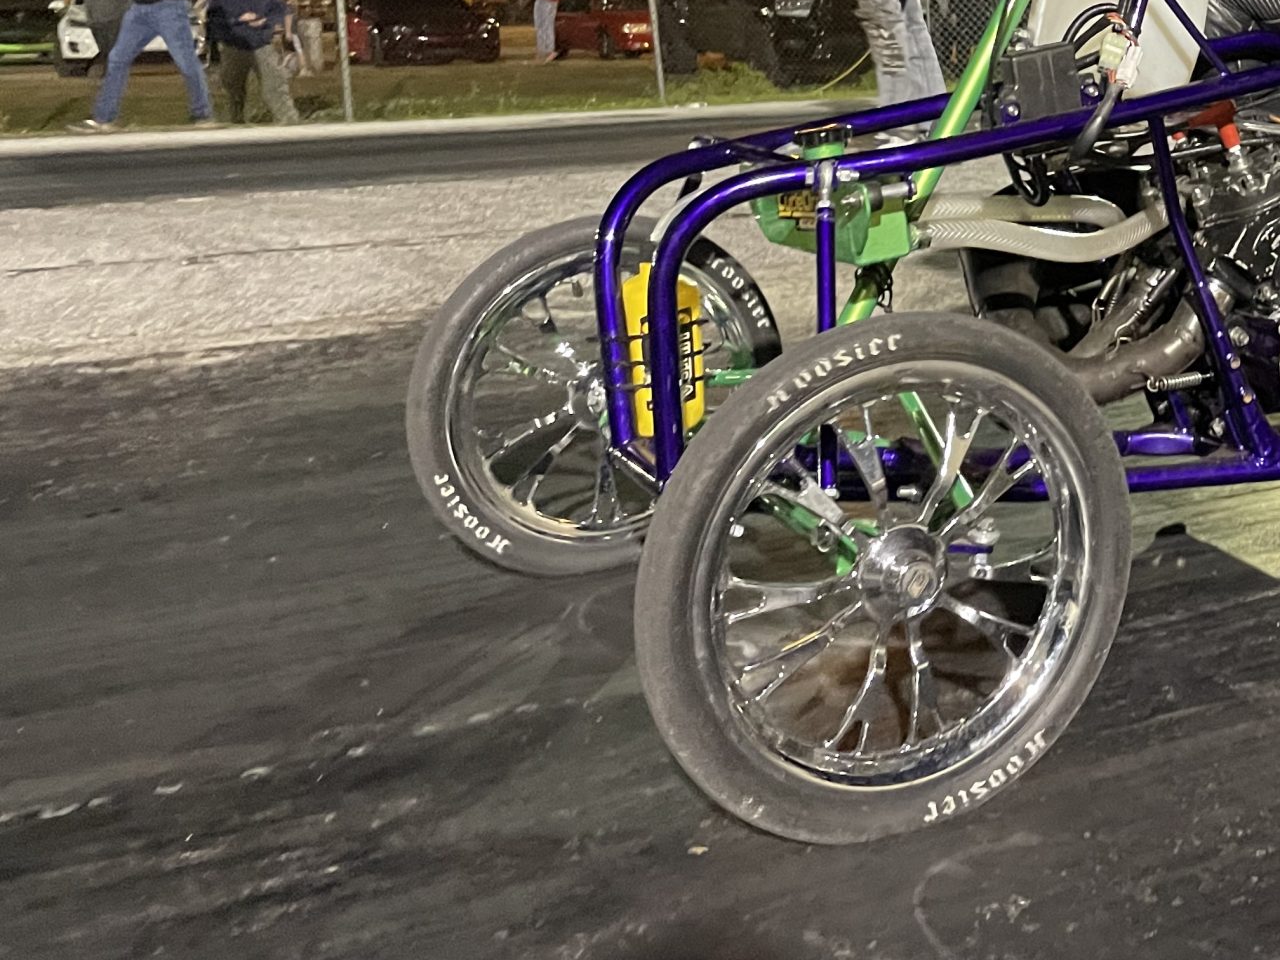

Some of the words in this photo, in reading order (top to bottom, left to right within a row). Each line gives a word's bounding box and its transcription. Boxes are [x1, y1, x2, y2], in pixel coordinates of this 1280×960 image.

[765, 333, 903, 415] Hoosier
[433, 473, 512, 555] Hoosier
[922, 728, 1048, 824] Hoosier
